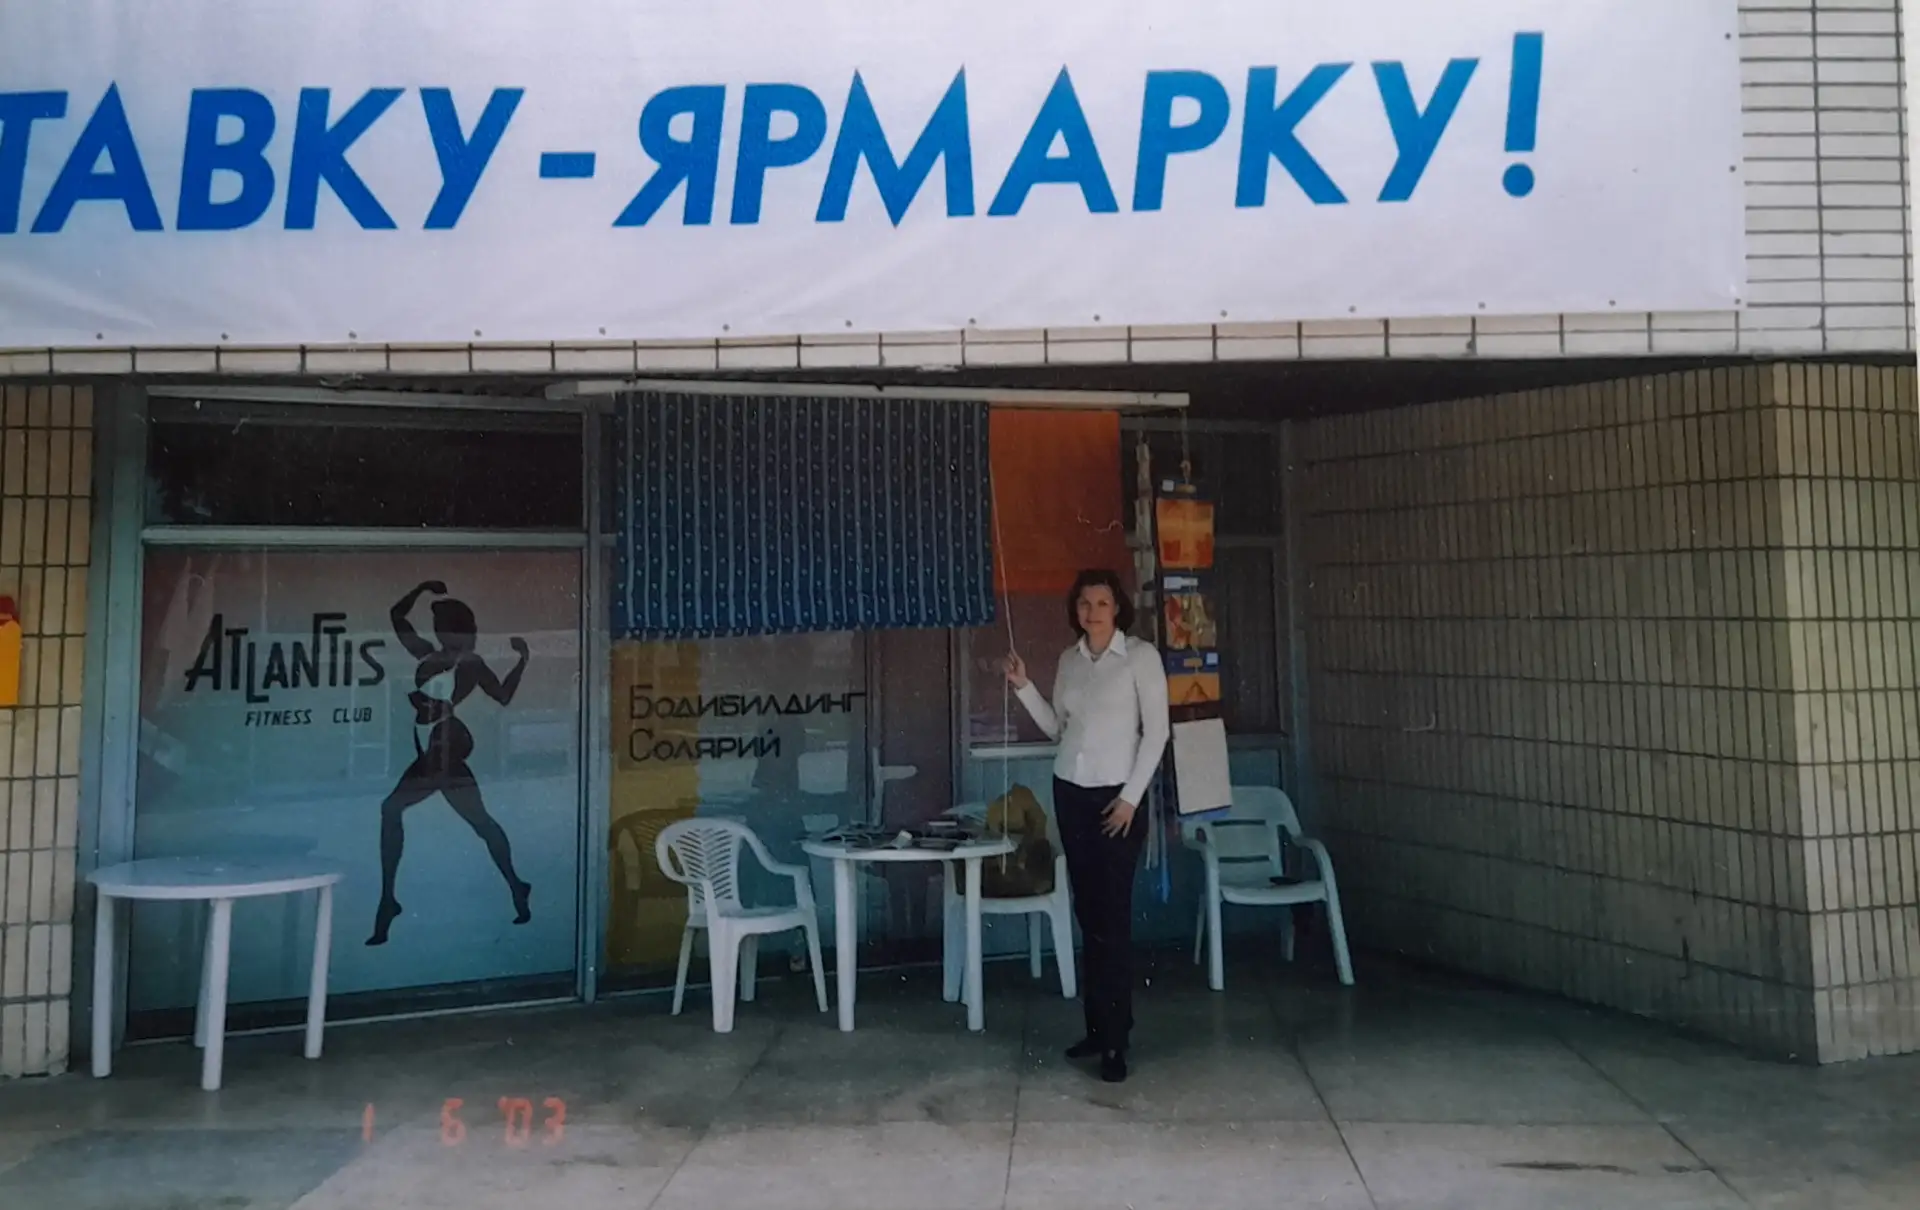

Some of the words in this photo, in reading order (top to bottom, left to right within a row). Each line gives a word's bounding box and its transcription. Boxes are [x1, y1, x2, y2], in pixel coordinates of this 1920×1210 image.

[184, 612, 386, 703] ATLANTIS
[244, 708, 314, 727] FITNESS
[332, 706, 373, 724] CLUB
